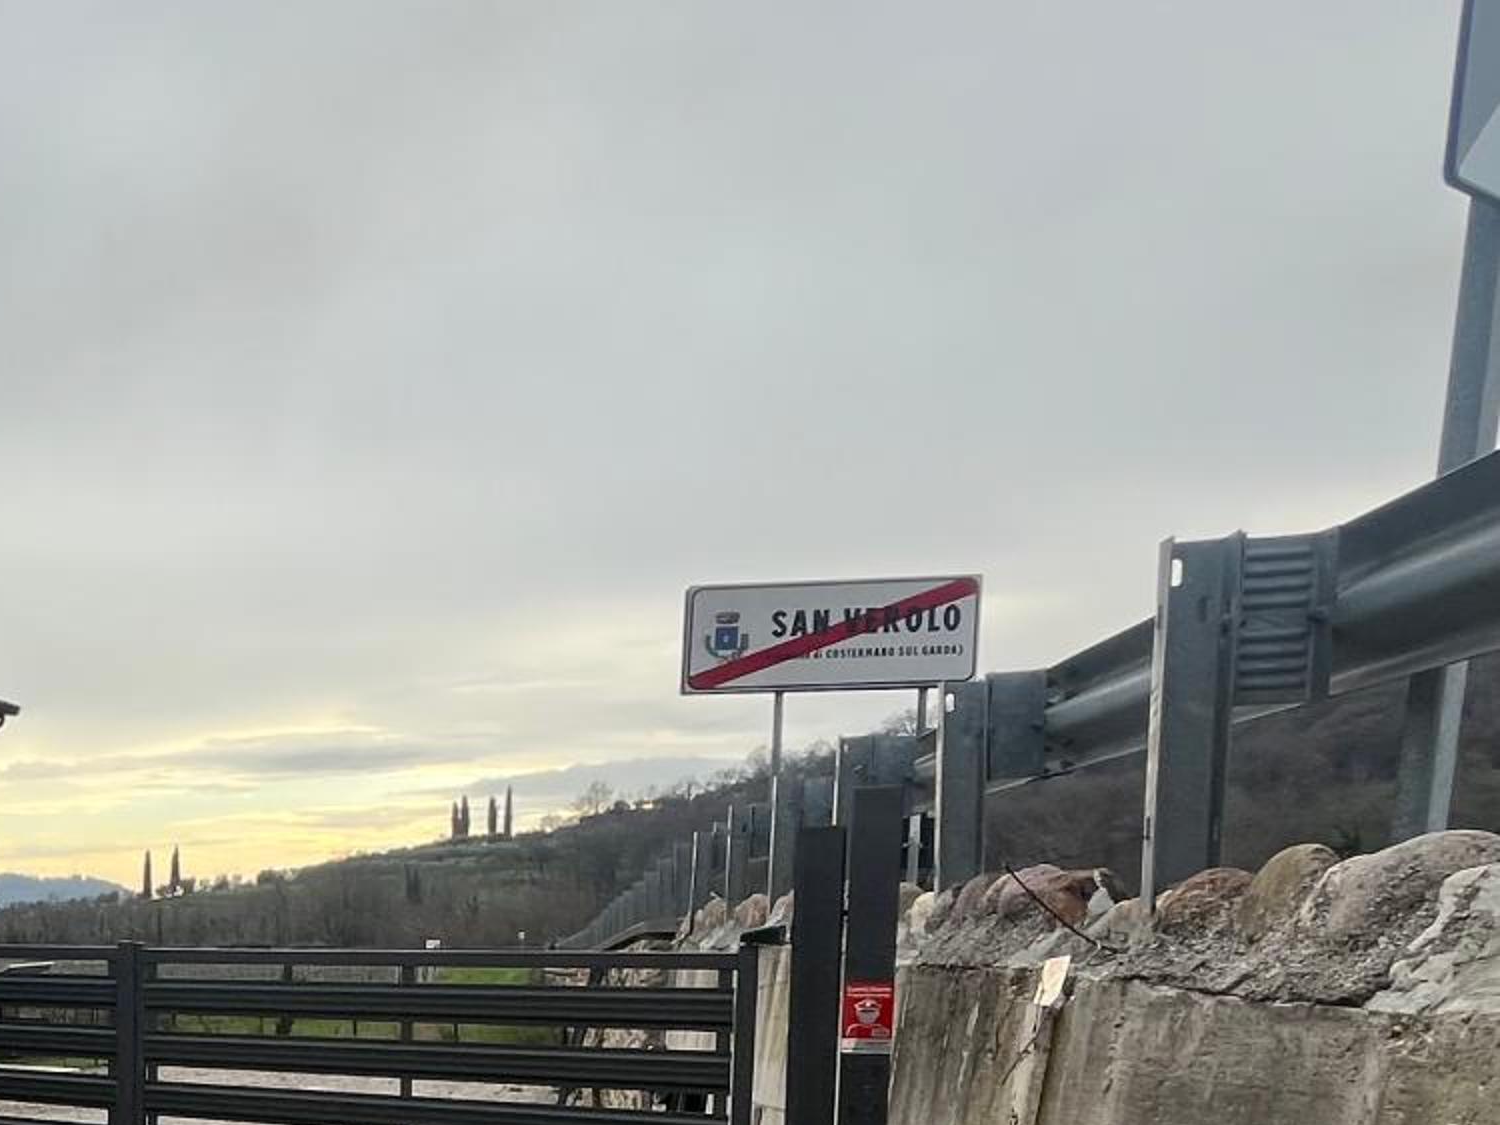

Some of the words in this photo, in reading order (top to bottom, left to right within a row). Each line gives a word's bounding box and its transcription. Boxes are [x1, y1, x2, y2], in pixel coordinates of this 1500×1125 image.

[772, 608, 830, 637] SAN
[844, 604, 961, 633] VEROLO
[898, 645, 918, 657] SUL
